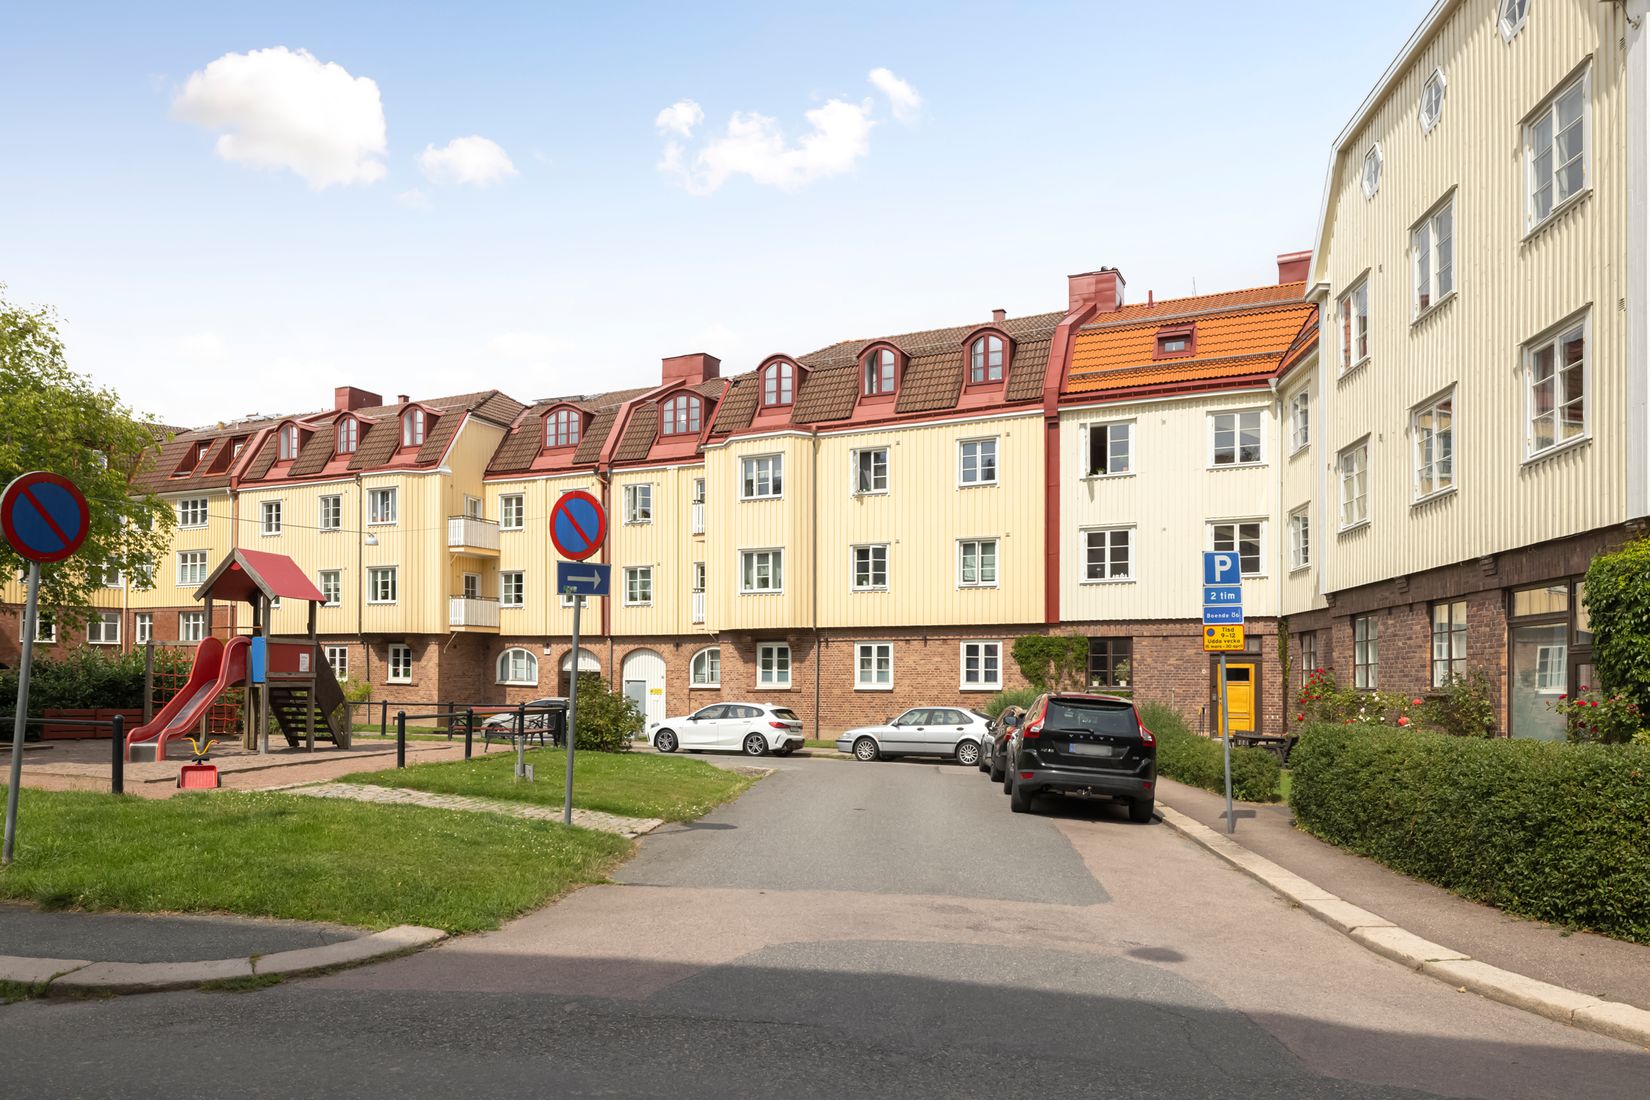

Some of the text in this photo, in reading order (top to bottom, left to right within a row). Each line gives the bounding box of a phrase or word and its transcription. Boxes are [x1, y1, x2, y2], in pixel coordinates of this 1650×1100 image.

[1214, 555, 1232, 582] P
[1210, 592, 1236, 600] 2 tim
